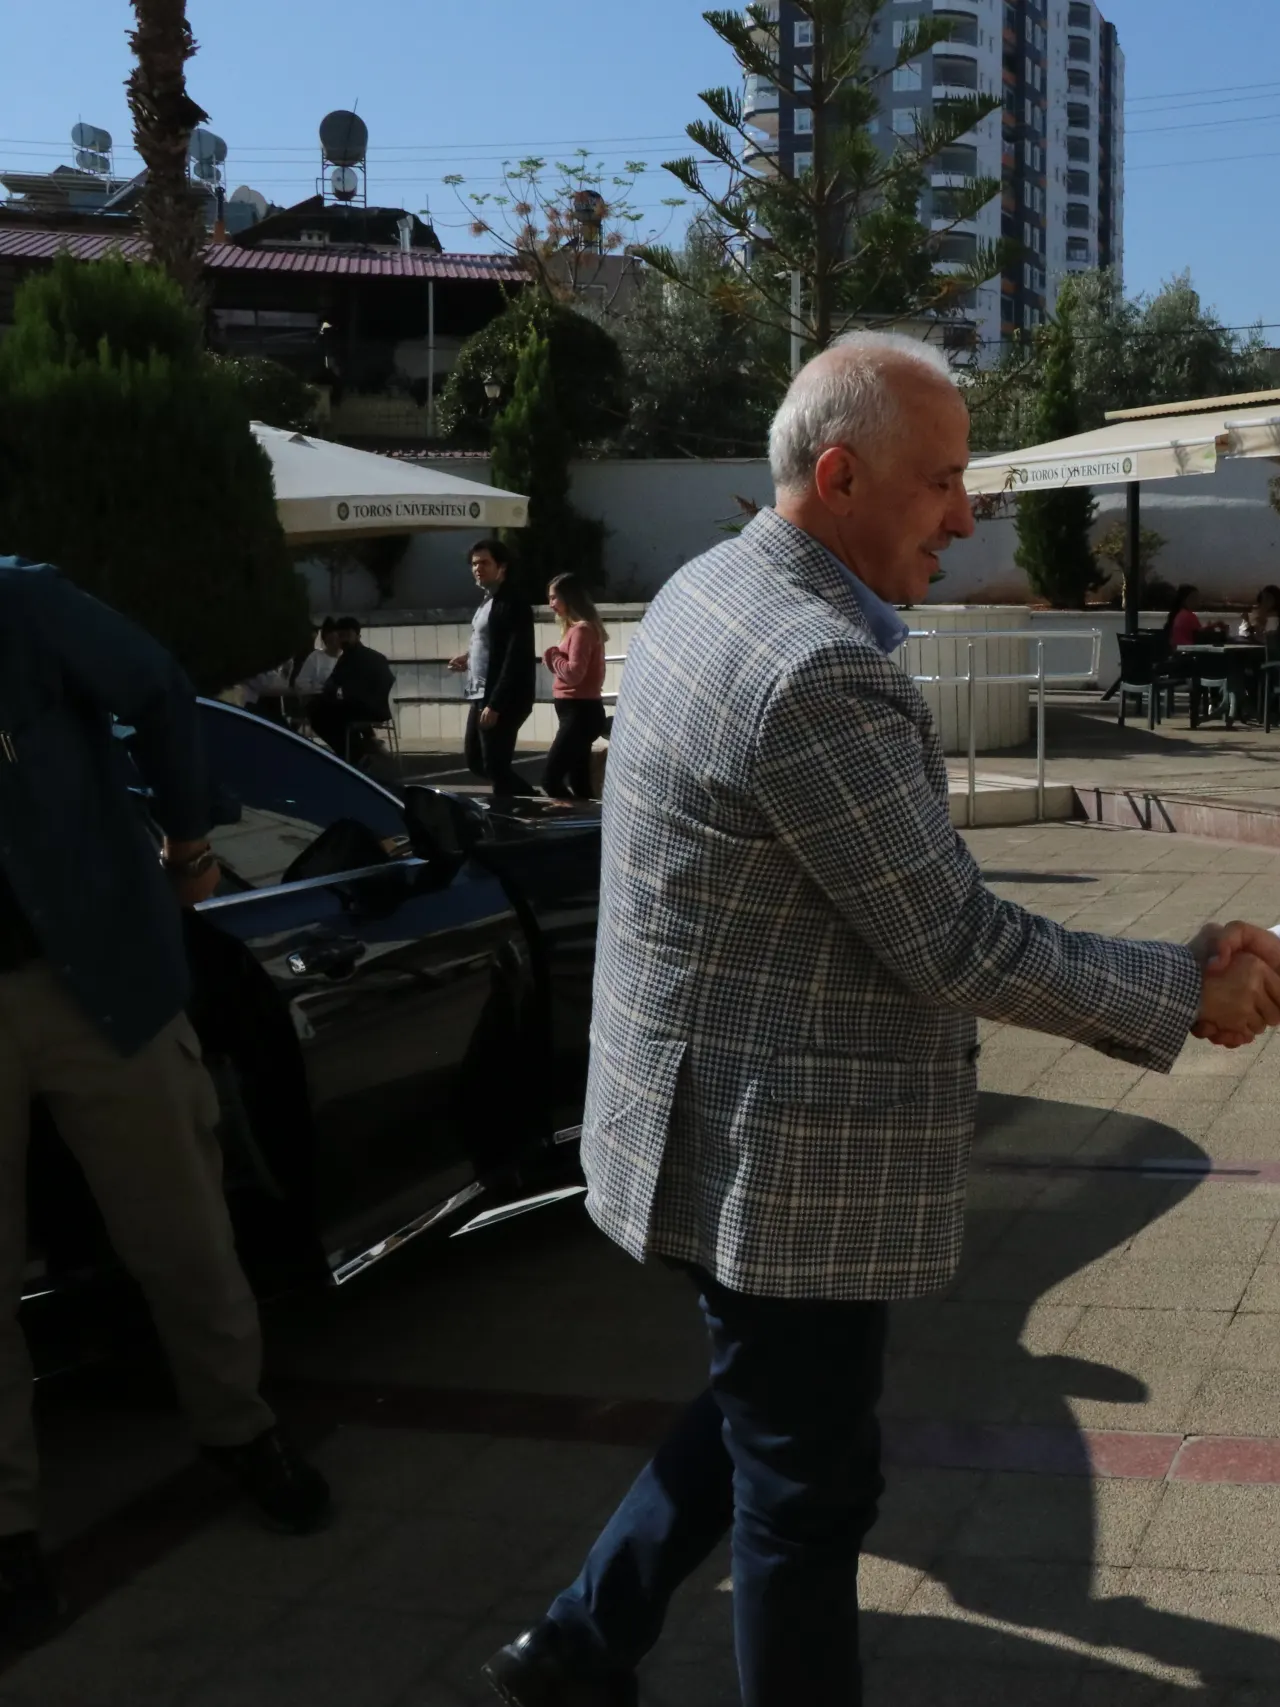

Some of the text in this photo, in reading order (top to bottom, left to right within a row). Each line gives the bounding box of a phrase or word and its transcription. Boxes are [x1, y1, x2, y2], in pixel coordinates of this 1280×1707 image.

[1031, 469, 1059, 482] TOROS
[353, 501, 466, 518] TOROS ÜNİVERSİTESİ
